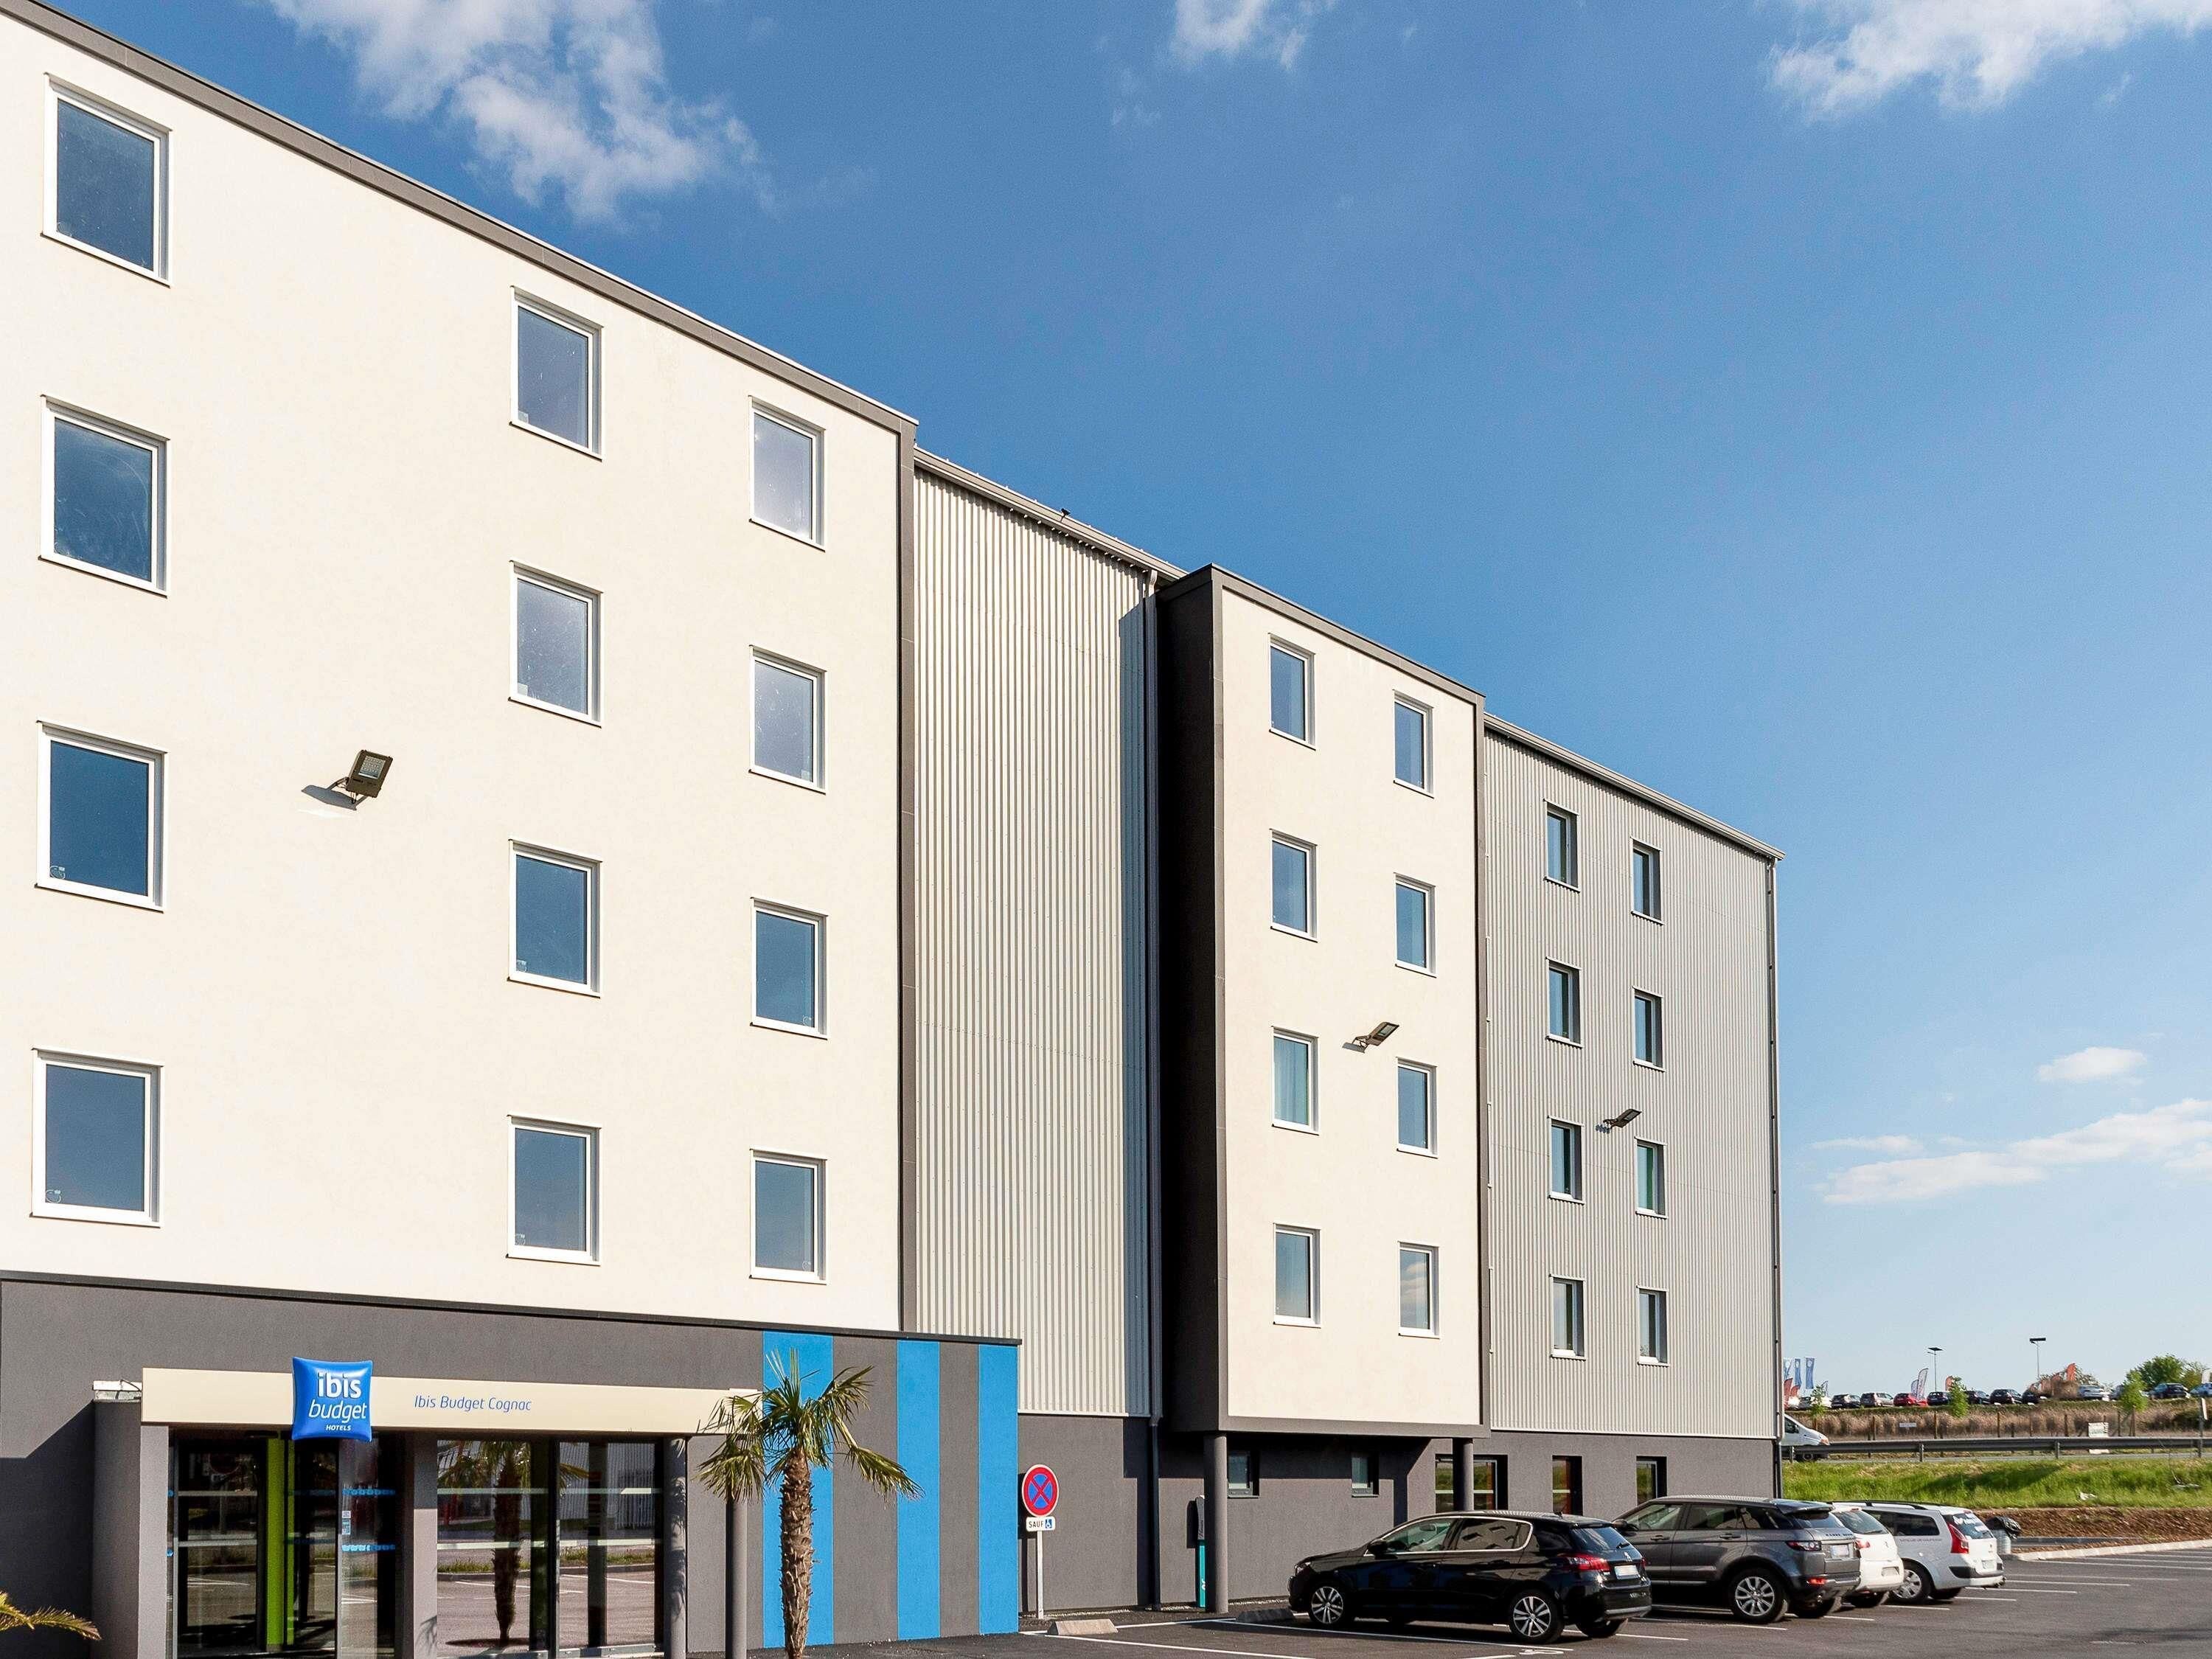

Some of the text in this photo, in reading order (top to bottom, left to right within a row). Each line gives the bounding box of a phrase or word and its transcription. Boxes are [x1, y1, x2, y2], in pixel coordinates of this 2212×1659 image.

[318, 1371, 361, 1398] ibis
[308, 1399, 367, 1423] budget
[414, 1395, 532, 1413] Ibis Budget Cognac
[1029, 1520, 1043, 1528] SAUF
